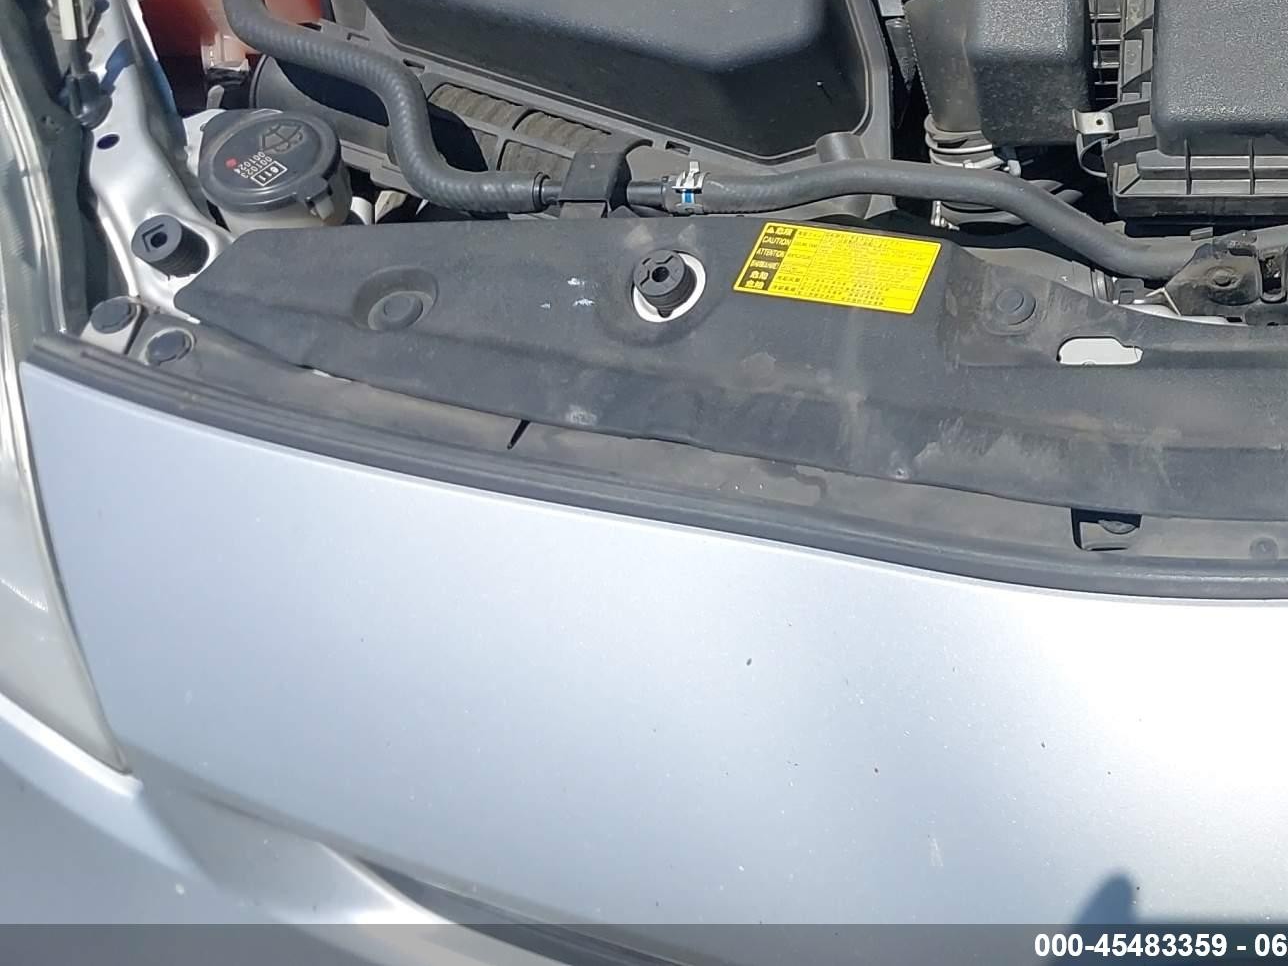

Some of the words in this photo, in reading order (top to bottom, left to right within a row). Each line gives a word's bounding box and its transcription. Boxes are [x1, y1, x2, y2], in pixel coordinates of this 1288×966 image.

[240, 156, 273, 179] 001023
[762, 236, 791, 245] CAUTION
[756, 248, 785, 257] ATTENTION
